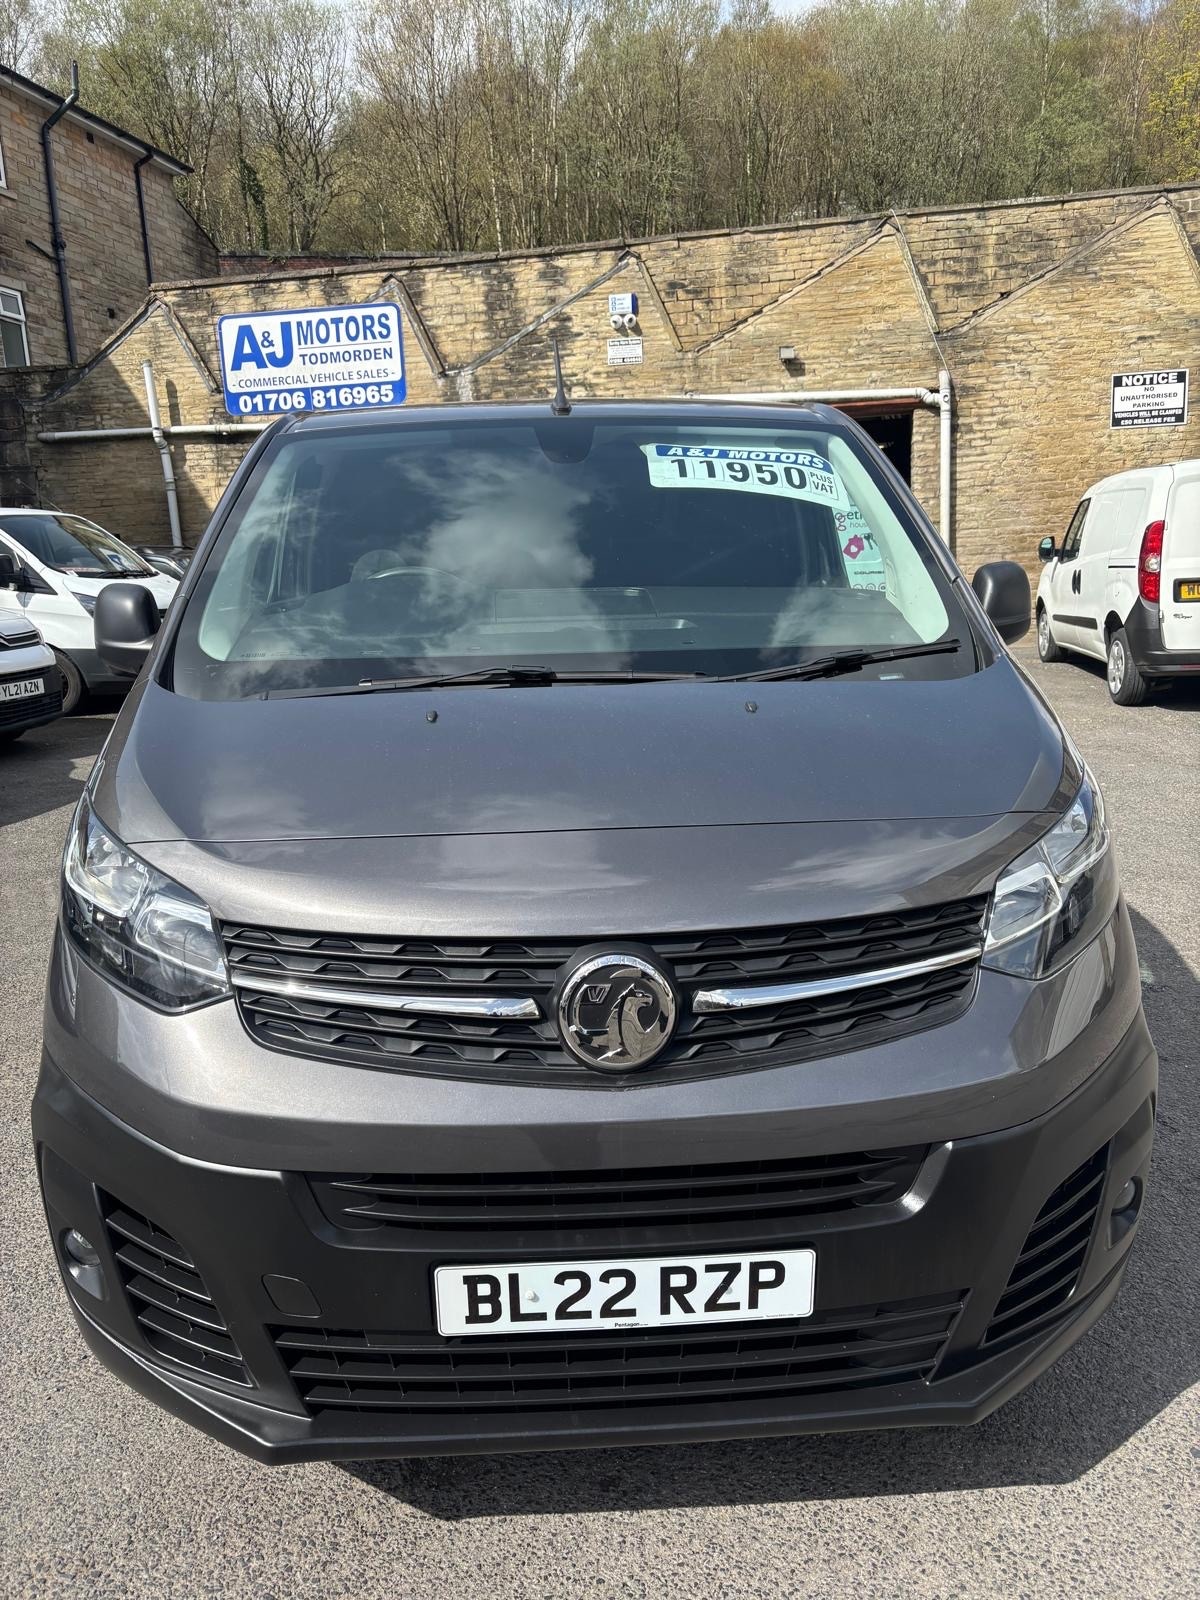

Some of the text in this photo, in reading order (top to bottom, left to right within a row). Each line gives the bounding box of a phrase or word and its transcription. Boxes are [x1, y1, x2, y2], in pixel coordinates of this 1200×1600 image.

[231, 313, 391, 371] A&J MOTORS
[300, 347, 393, 366] TODMORDEN
[238, 375, 308, 389] COMMERCIAL
[310, 371, 354, 383] VEHICLE
[357, 368, 389, 380] SALES
[1122, 372, 1178, 387] NOTICE
[239, 385, 394, 413] 01706 816965
[1120, 392, 1178, 401] UNAUTHORISED
[727, 450, 824, 469] MOTORS
[671, 458, 807, 490] 11950
[810, 471, 833, 484] PLUS
[812, 480, 834, 495] VAT
[24, 680, 39, 694] AZN
[462, 1260, 786, 1325] BL22 RZP
